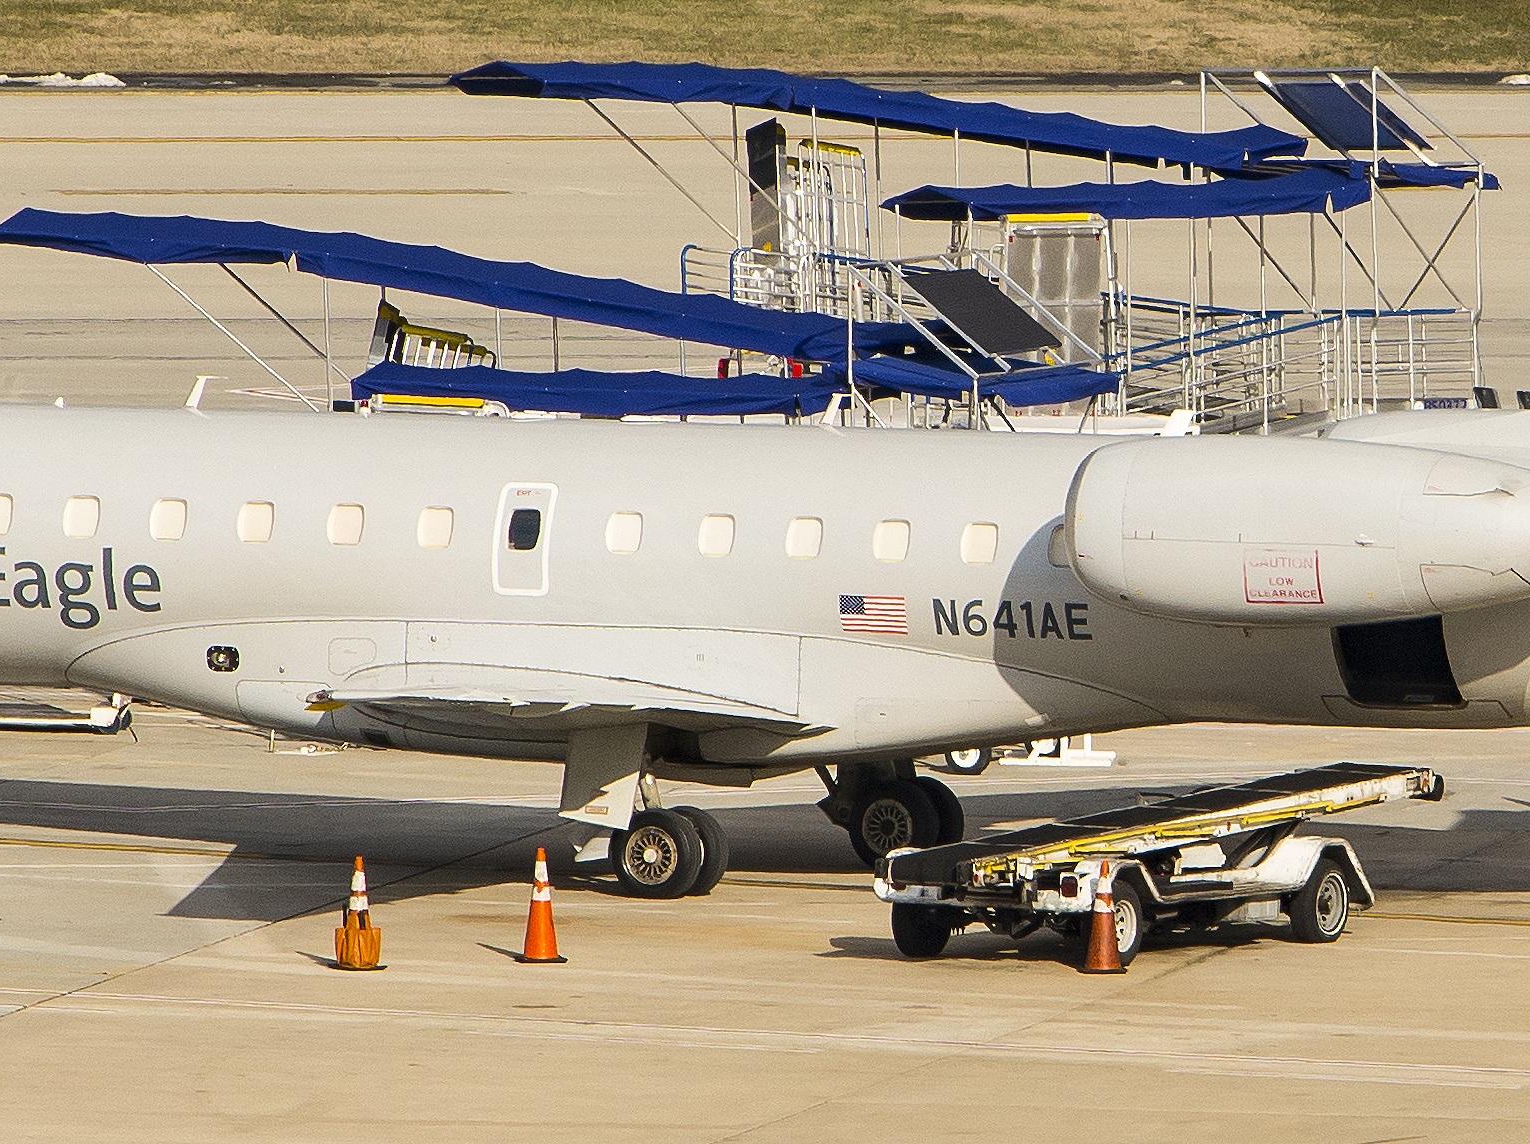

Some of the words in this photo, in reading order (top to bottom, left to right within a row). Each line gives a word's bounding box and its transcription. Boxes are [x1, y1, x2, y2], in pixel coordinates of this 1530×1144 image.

[1250, 556, 1314, 569] CAUTION
[1269, 577, 1294, 586] LOW
[1249, 589, 1318, 599] CLEARANCE
[932, 598, 1093, 641] N641AE
